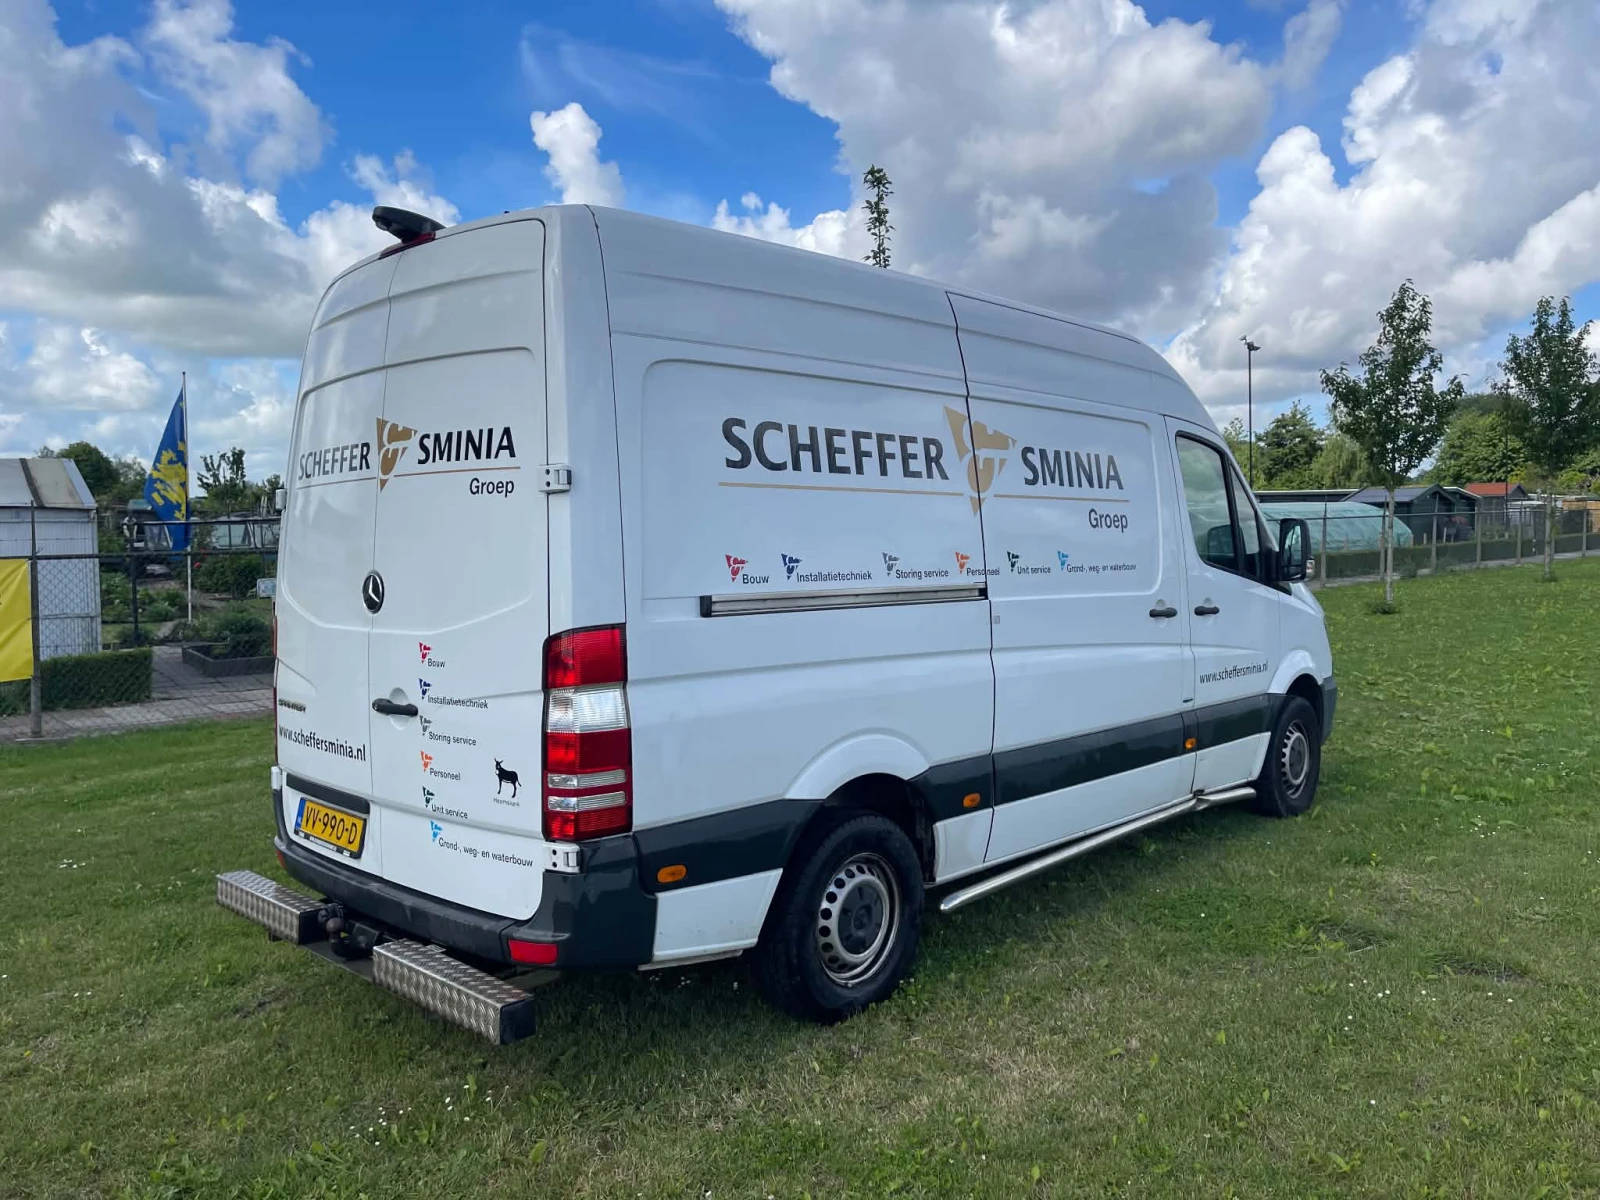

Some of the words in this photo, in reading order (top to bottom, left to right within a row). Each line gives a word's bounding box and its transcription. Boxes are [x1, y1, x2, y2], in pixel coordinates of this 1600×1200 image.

[298, 441, 371, 481] SCHEFFER
[417, 426, 517, 465] SMINIA
[721, 417, 950, 481] SCHEFFER
[1020, 446, 1125, 491] SMINIA
[469, 477, 515, 498] Groep
[1088, 507, 1129, 533] Groep
[796, 570, 873, 583] Installatietechniek
[895, 568, 923, 581] Storing
[923, 568, 949, 578] service
[1030, 564, 1052, 575] service
[742, 573, 770, 585] Bouw
[427, 657, 446, 668] Bouw
[1199, 659, 1269, 685] www.scheffersminia.nl
[427, 694, 489, 710] Installatietechniek
[278, 724, 367, 762] www.scheffersminia.nl
[428, 730, 451, 745] Storing
[452, 735, 477, 747] service
[429, 767, 461, 781] Personeel
[431, 803, 445, 815] Unit
[445, 807, 469, 820] service
[304, 805, 358, 845] VV-990-D
[463, 845, 480, 858] weg-
[481, 848, 490, 859] en
[491, 851, 534, 868] waterbouw
